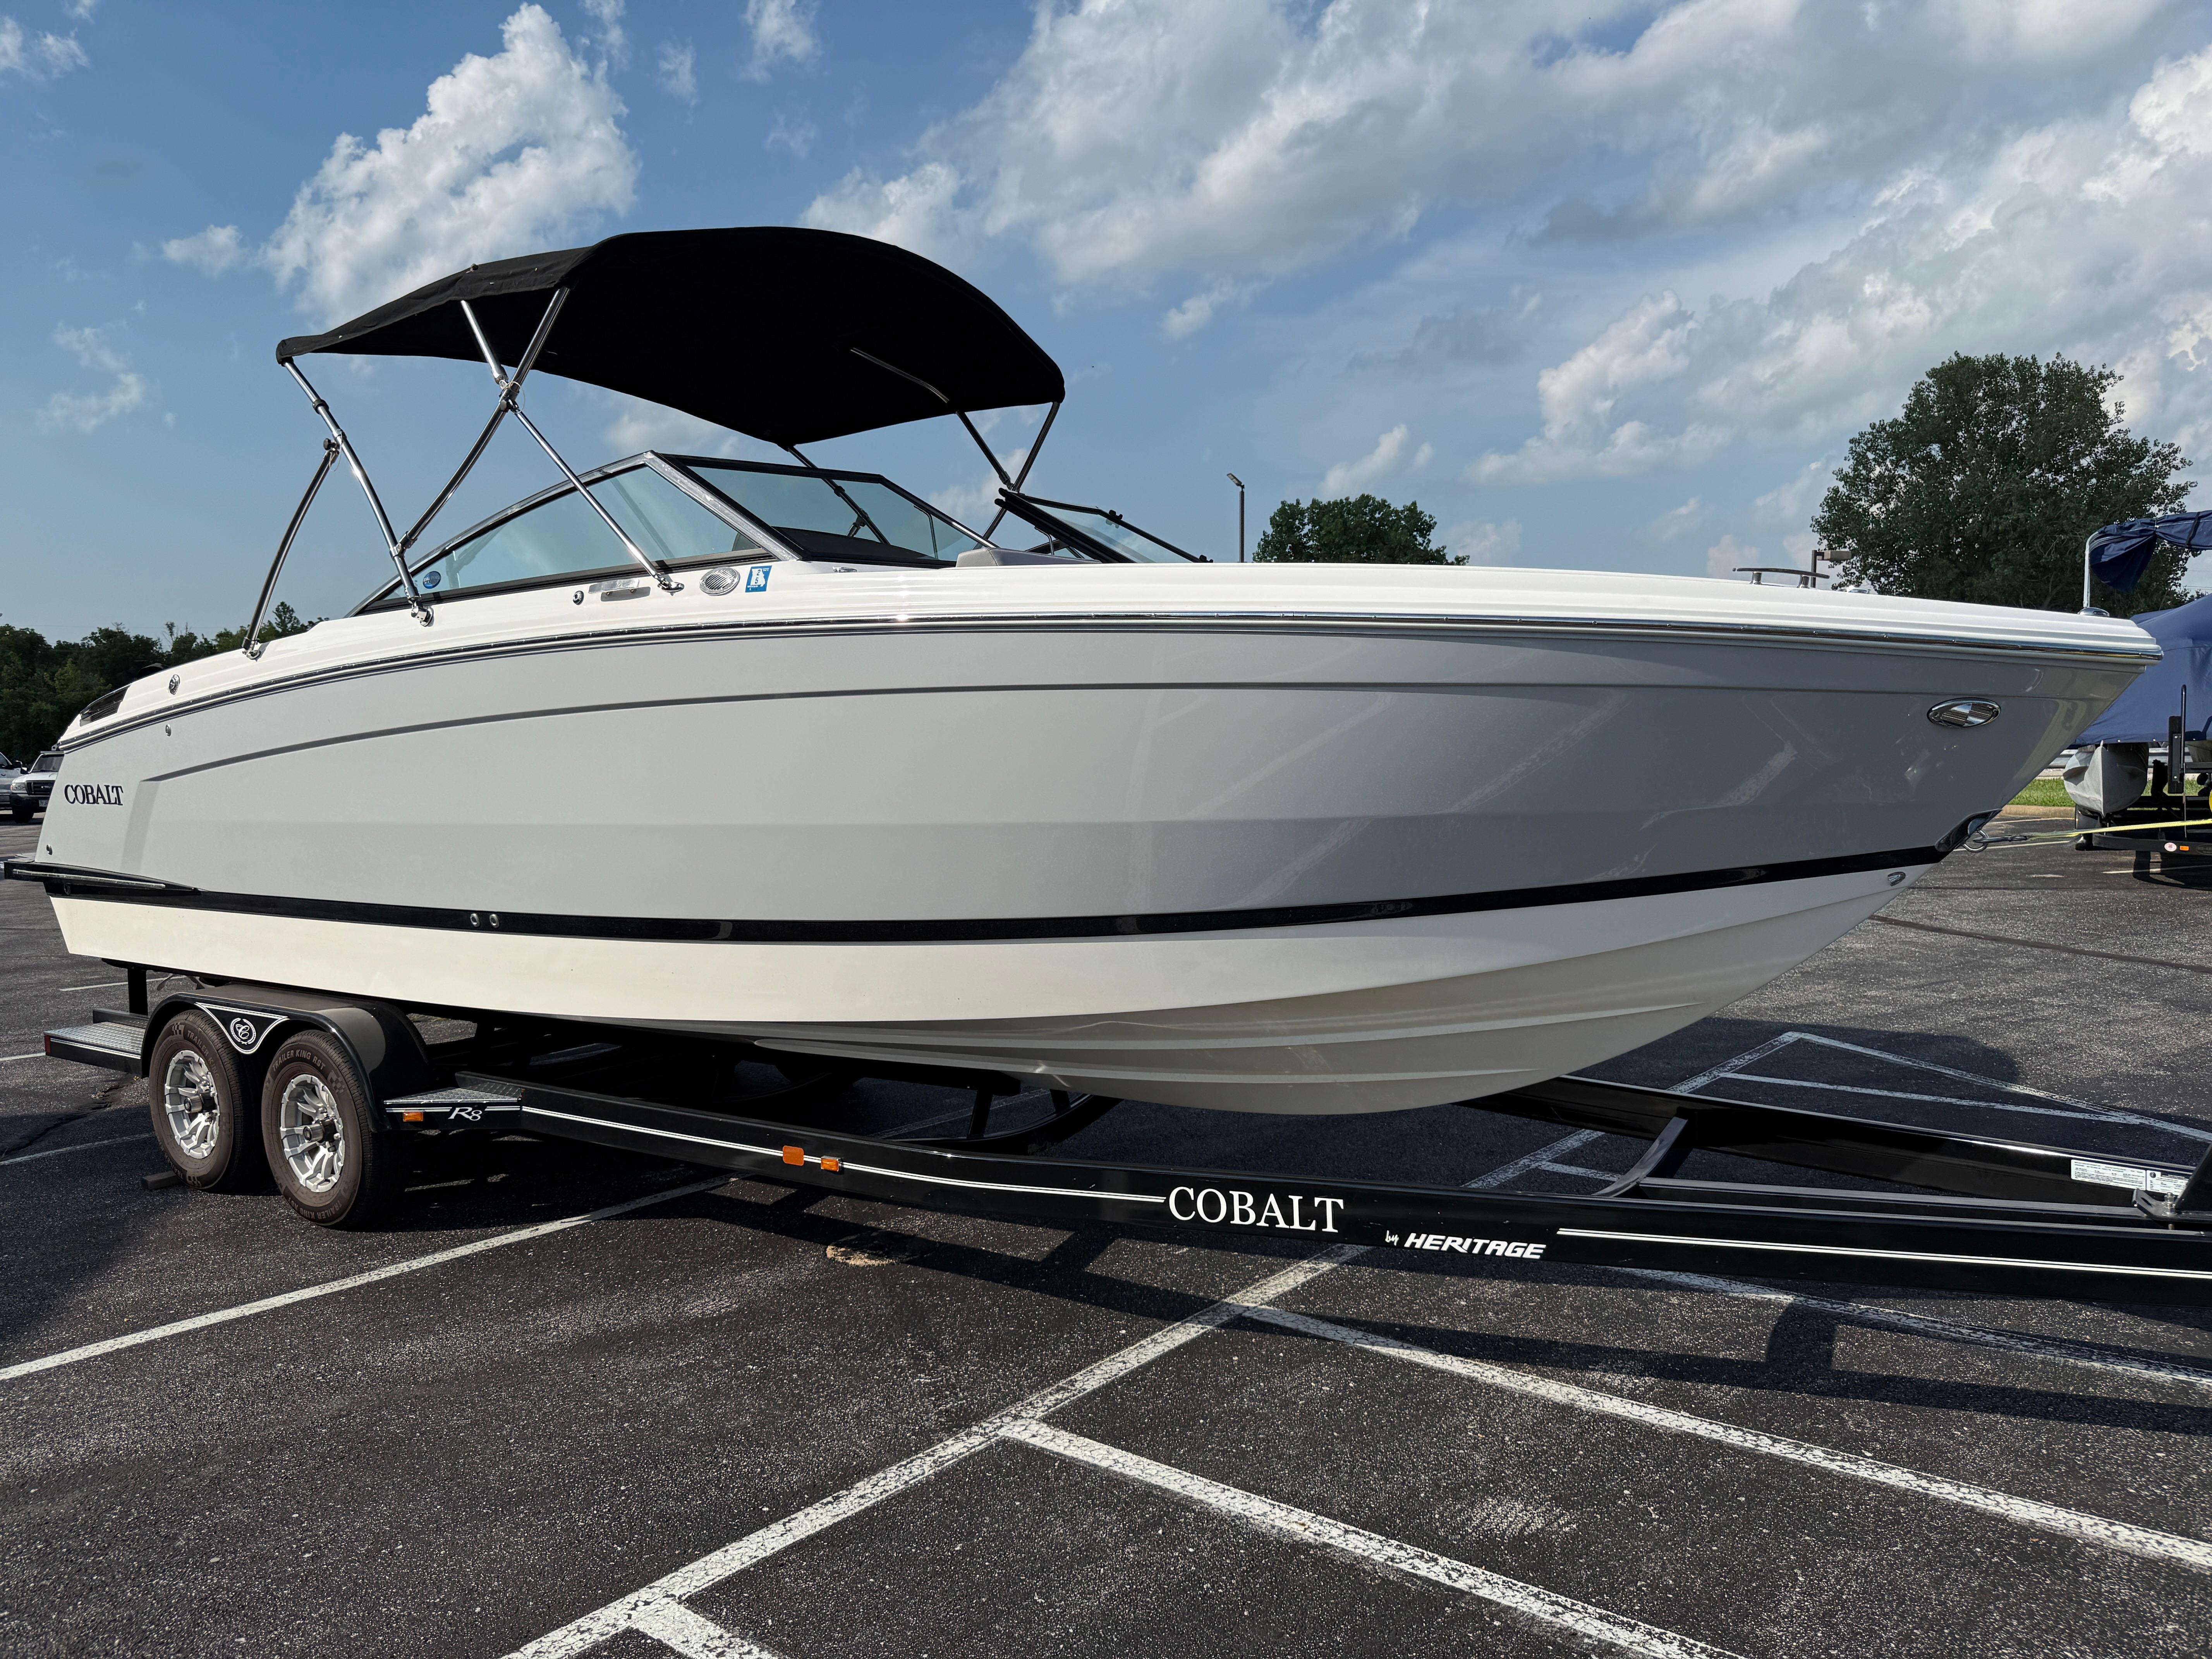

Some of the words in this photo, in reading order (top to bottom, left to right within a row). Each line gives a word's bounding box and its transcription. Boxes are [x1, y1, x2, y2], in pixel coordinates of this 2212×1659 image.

[64, 784, 124, 805] COBALT
[187, 1030, 209, 1056] TRAILER
[272, 1050, 294, 1072] TRAILER
[295, 1049, 311, 1060] KING
[313, 1056, 326, 1070] RST
[448, 1107, 483, 1121] R8
[317, 1200, 342, 1219] TRAILER
[1169, 1186, 1344, 1233] COBALT
[1385, 1230, 1400, 1246] by
[1404, 1233, 1546, 1259] HERITAGE
